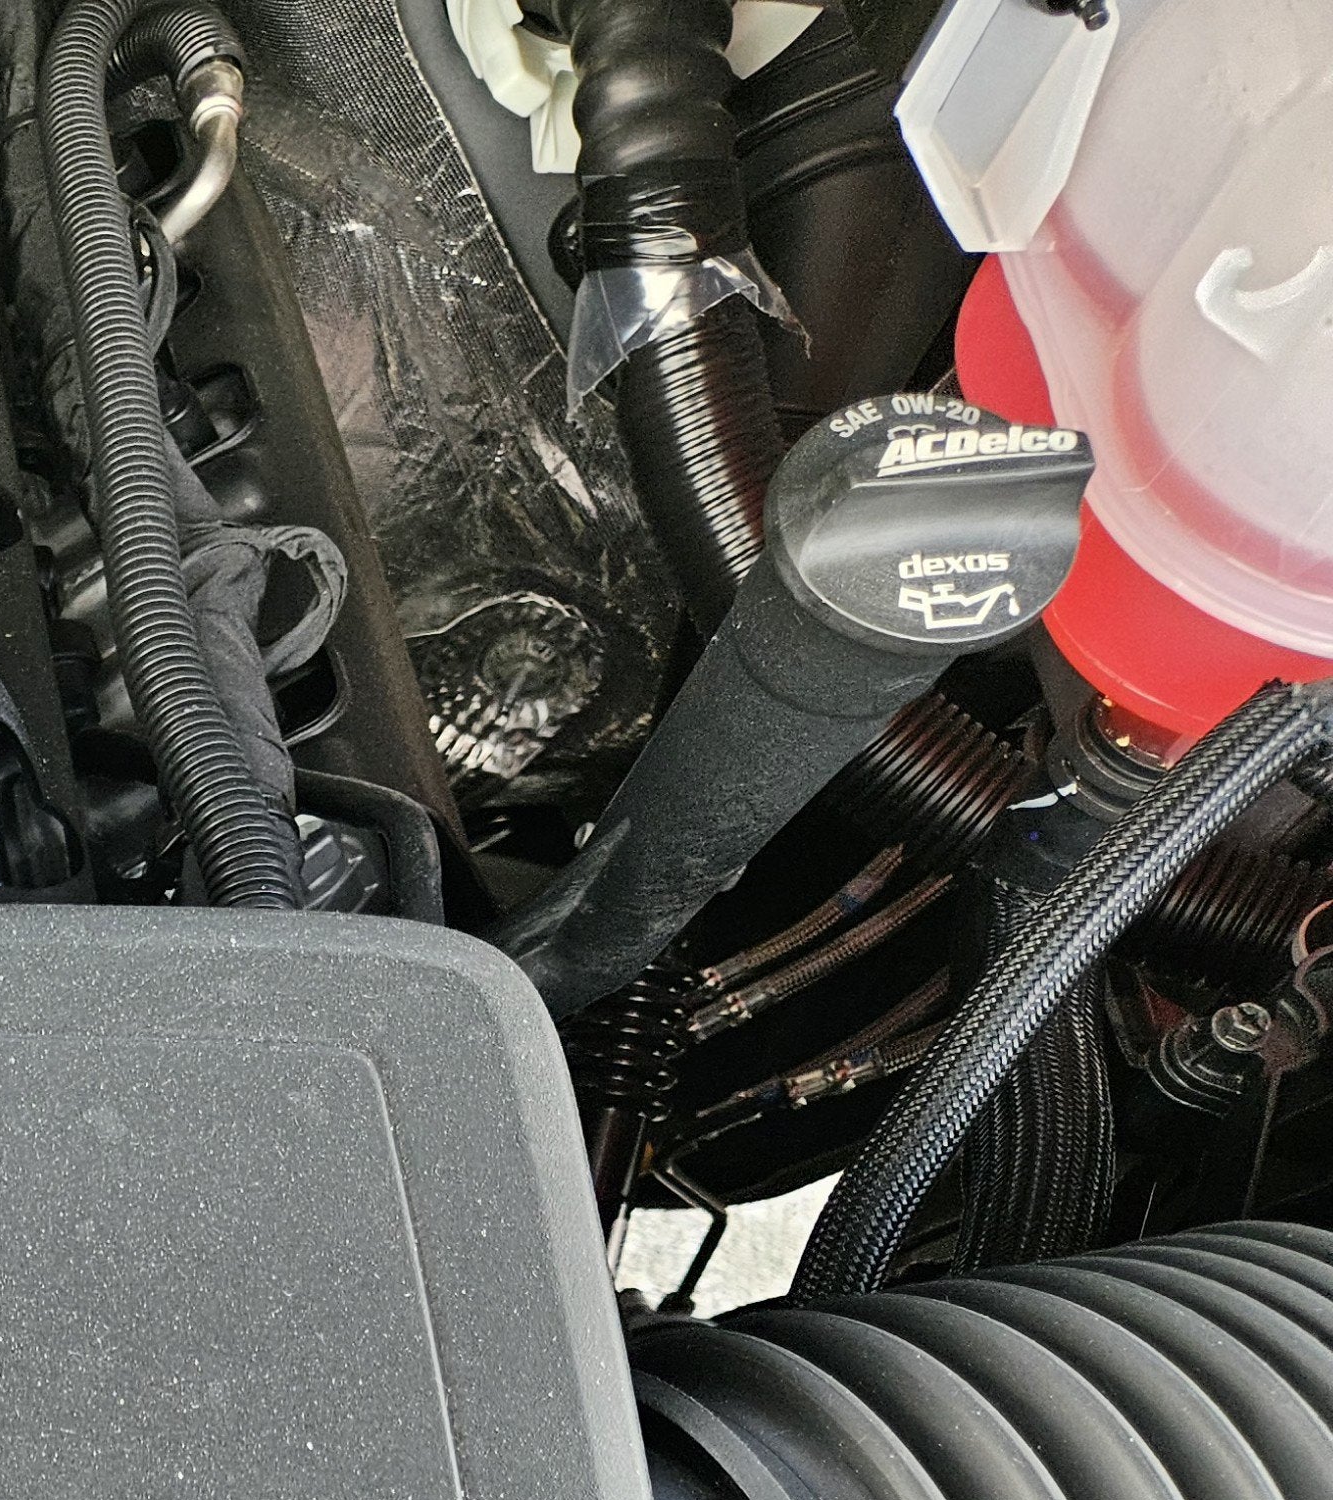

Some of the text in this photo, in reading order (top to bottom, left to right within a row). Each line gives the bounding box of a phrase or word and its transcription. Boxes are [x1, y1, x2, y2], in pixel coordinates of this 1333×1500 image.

[829, 394, 981, 438] SAE 0W-20
[876, 425, 1078, 470] ACDelco
[898, 553, 1010, 580] dexos
